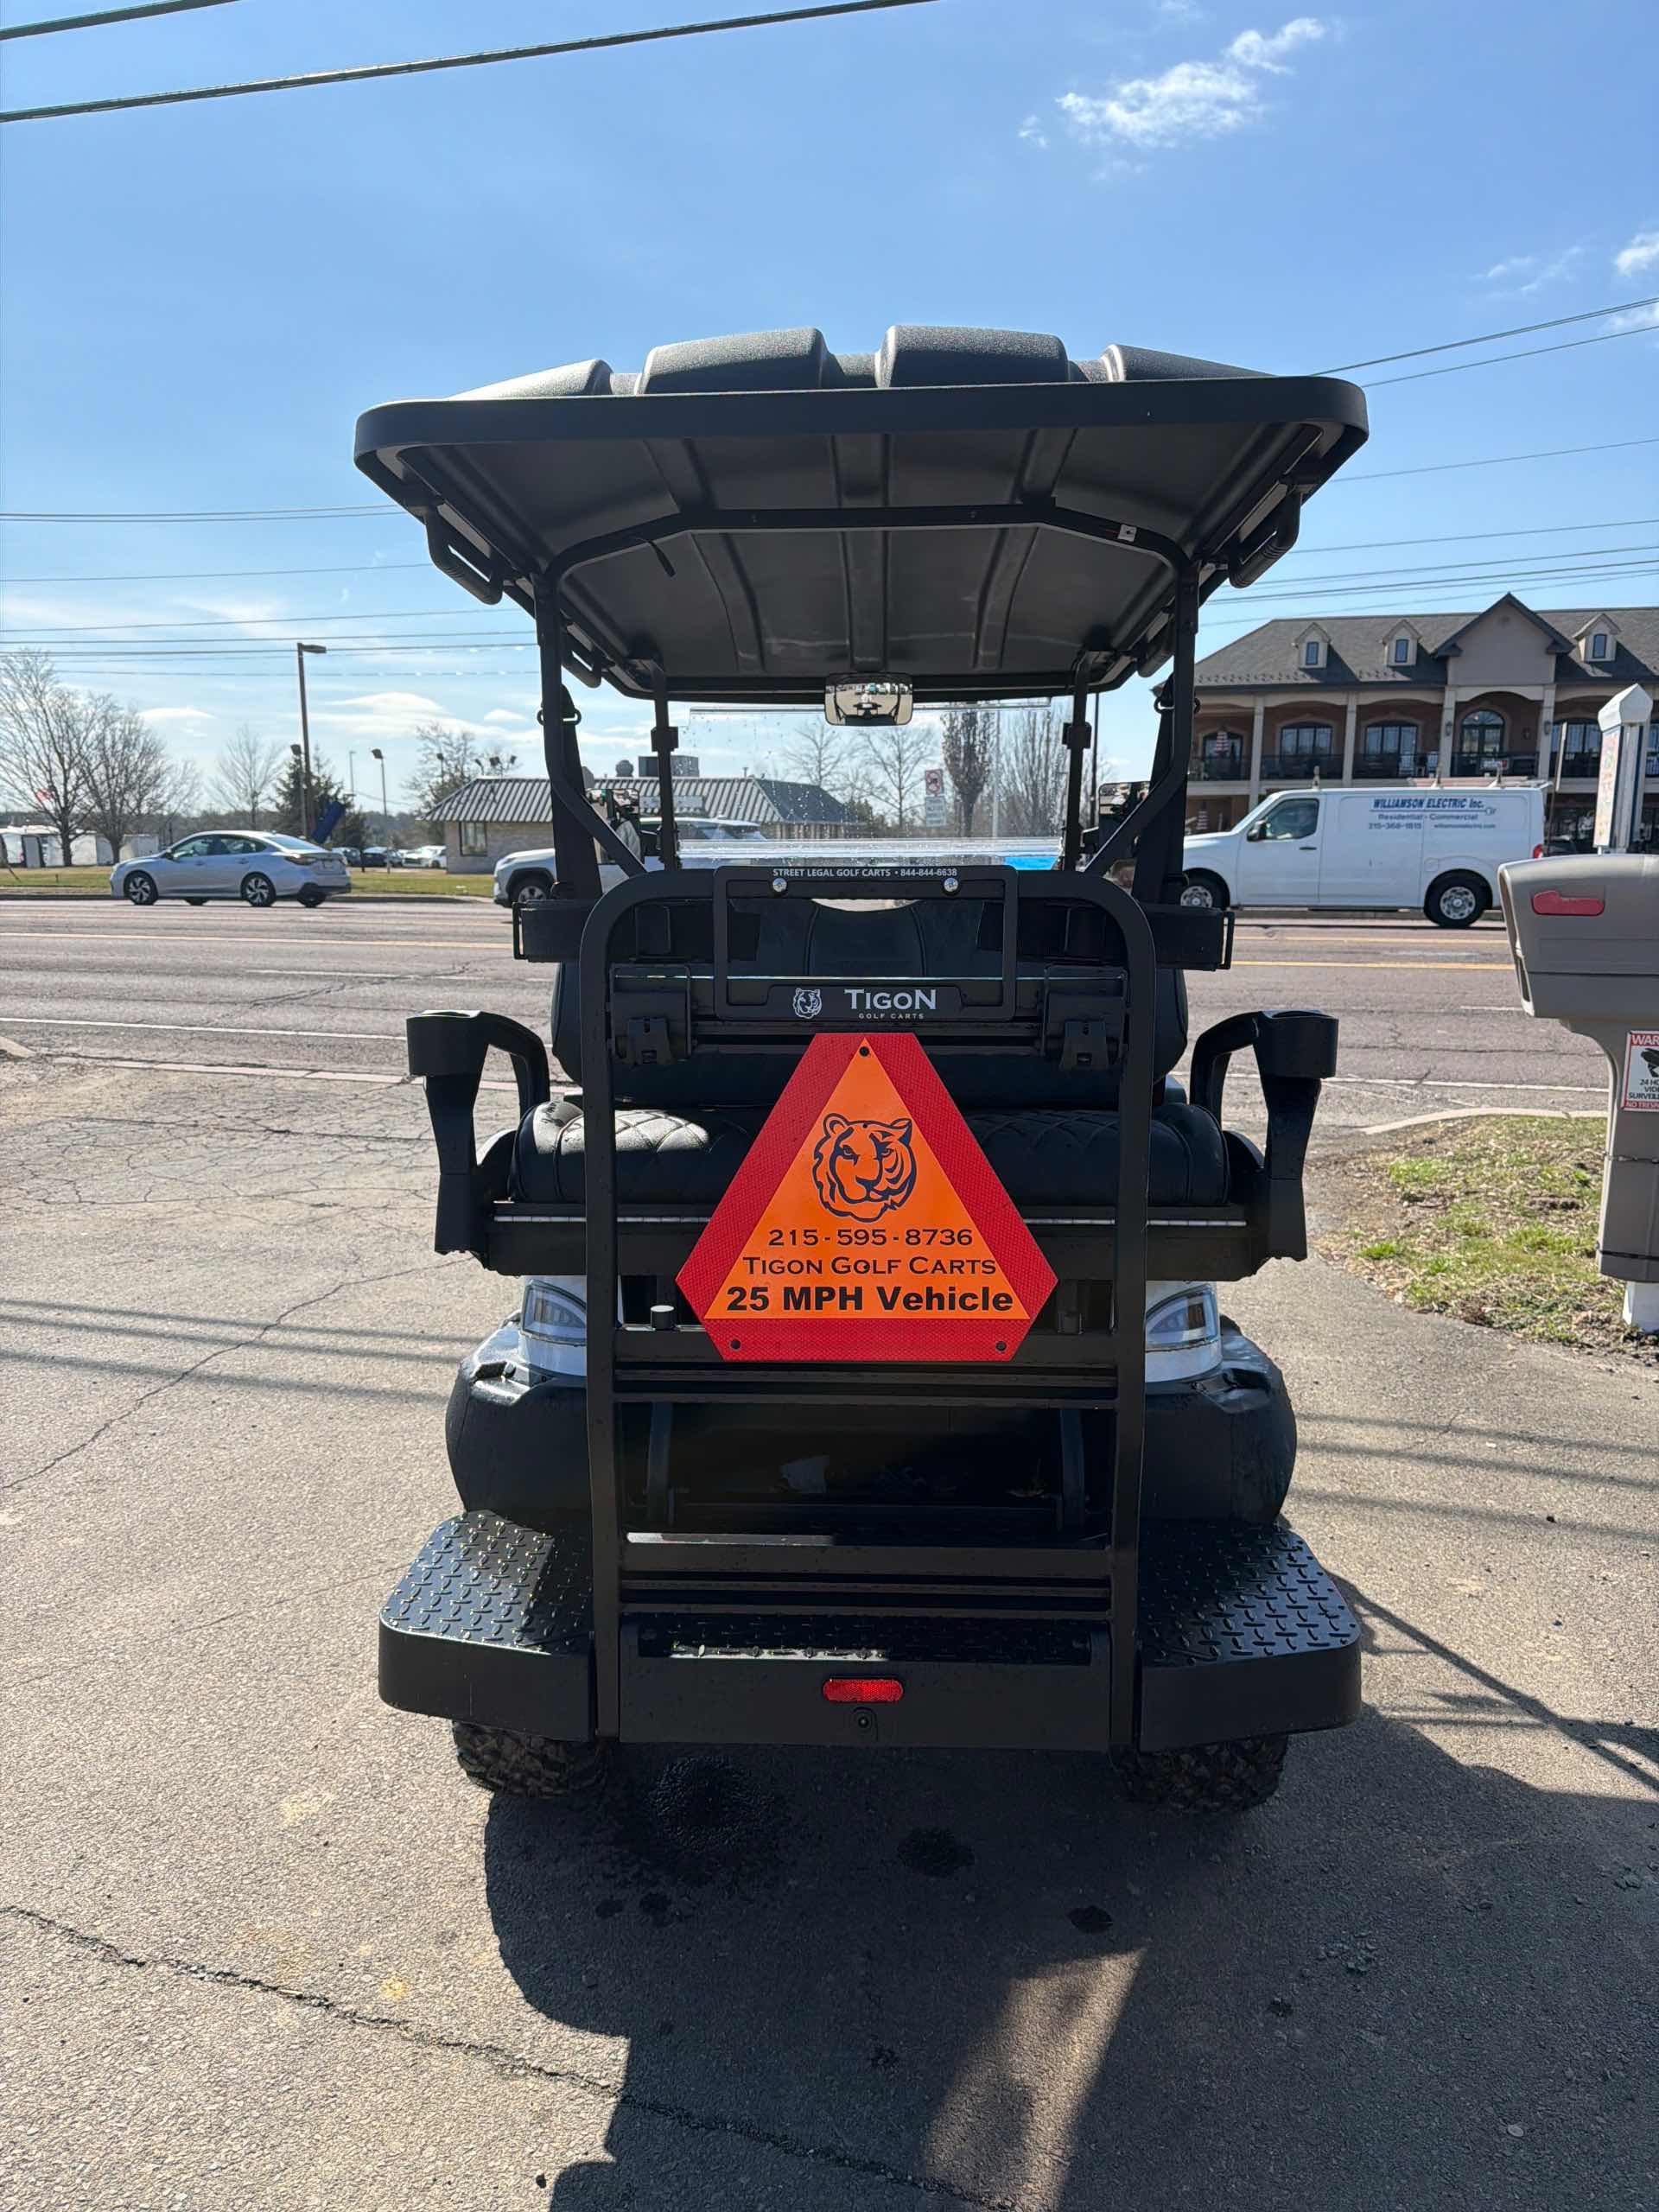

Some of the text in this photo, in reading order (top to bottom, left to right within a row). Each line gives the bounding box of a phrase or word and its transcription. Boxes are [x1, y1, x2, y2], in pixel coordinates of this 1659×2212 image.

[1373, 798, 1425, 809] WILLIAMSON
[1427, 798, 1466, 809] ELECTRIC
[772, 868, 957, 877] STREET LEGAL GOLF CARTS 844-844-6638
[844, 988, 936, 1010] TIGON
[742, 1256, 996, 1274] TIGON GOLF CARTS
[726, 1286, 1013, 1312] 25 MPH Vehicle
